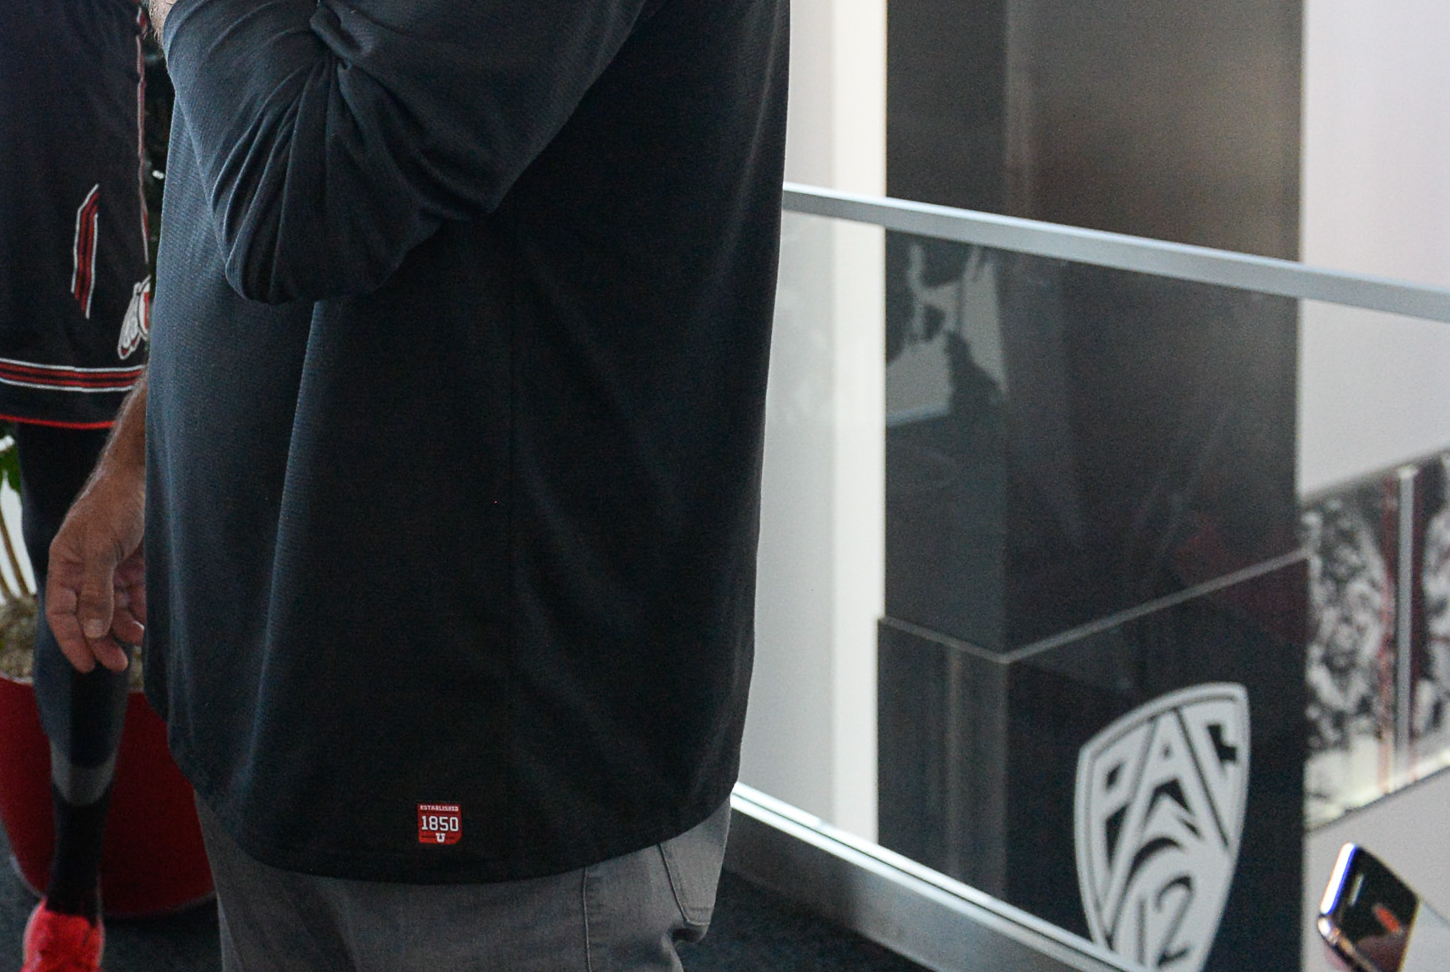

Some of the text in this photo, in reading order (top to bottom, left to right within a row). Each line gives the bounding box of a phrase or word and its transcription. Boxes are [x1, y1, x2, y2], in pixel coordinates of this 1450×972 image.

[1089, 696, 1250, 933] PAC
[421, 815, 460, 832] 1850
[435, 832, 447, 843] U
